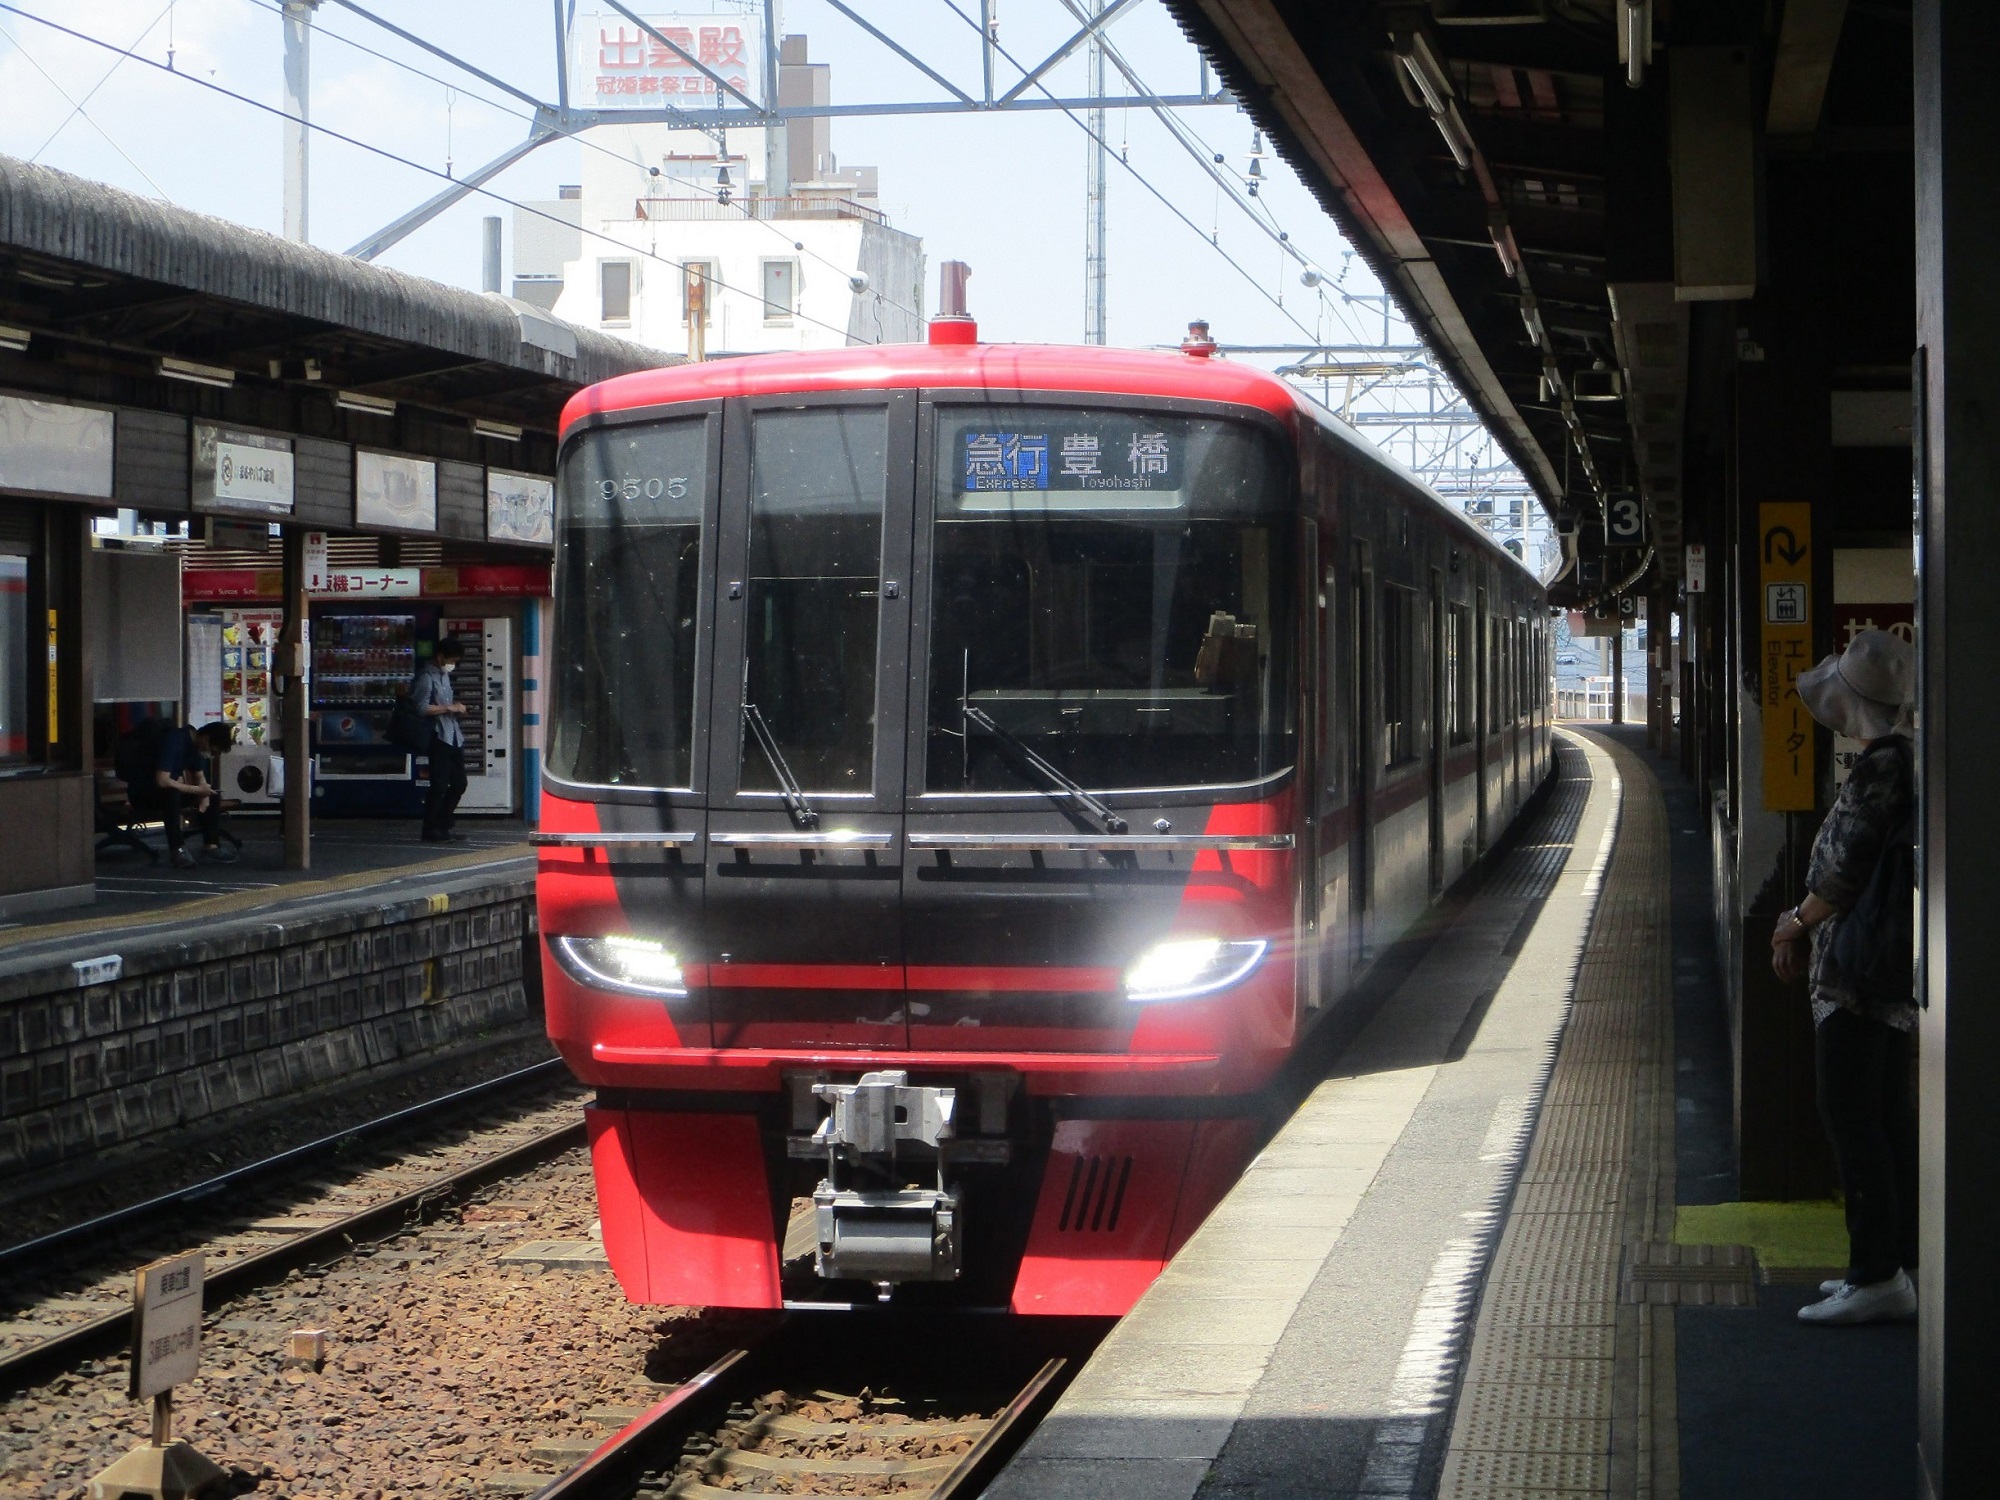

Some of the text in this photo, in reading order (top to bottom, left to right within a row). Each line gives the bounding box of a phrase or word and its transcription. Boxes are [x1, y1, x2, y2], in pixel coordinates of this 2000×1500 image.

[599, 26, 745, 69] 出雲殿
[966, 433, 1170, 475] 急行 豊橋
[599, 477, 688, 500] 9505
[975, 475, 1151, 489] Express Toyohashi
[1612, 499, 1640, 536] 3
[1621, 597, 1634, 614] 3
[1767, 640, 1781, 706] Elevator
